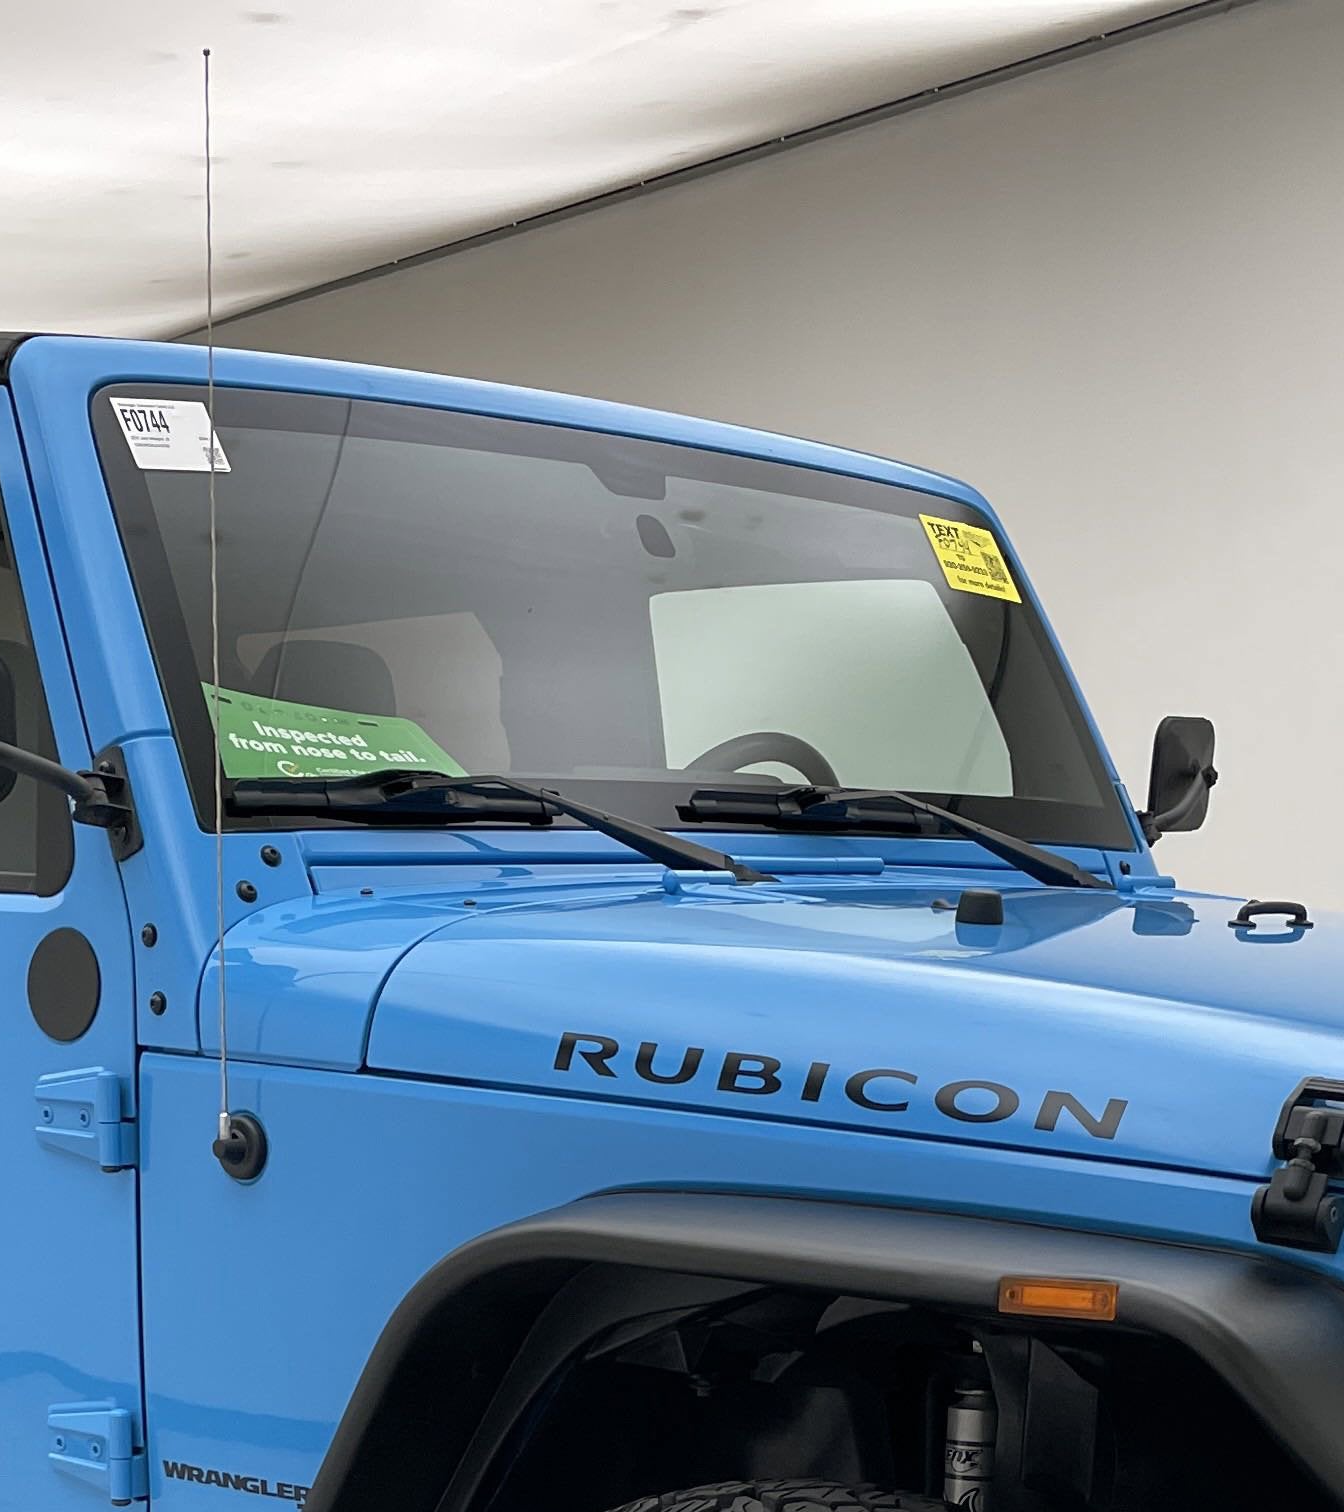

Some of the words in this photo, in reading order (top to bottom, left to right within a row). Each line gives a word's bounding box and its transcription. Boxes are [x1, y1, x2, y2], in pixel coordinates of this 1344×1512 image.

[119, 408, 170, 434] F0744
[926, 521, 960, 540] TEXT
[228, 733, 288, 755] from
[290, 744, 348, 760] nose
[349, 748, 377, 761] to
[378, 750, 427, 763] tail.
[252, 720, 368, 748] Inspected
[553, 1031, 1128, 1140] RUBICON
[163, 1460, 312, 1501] WRANGLER
